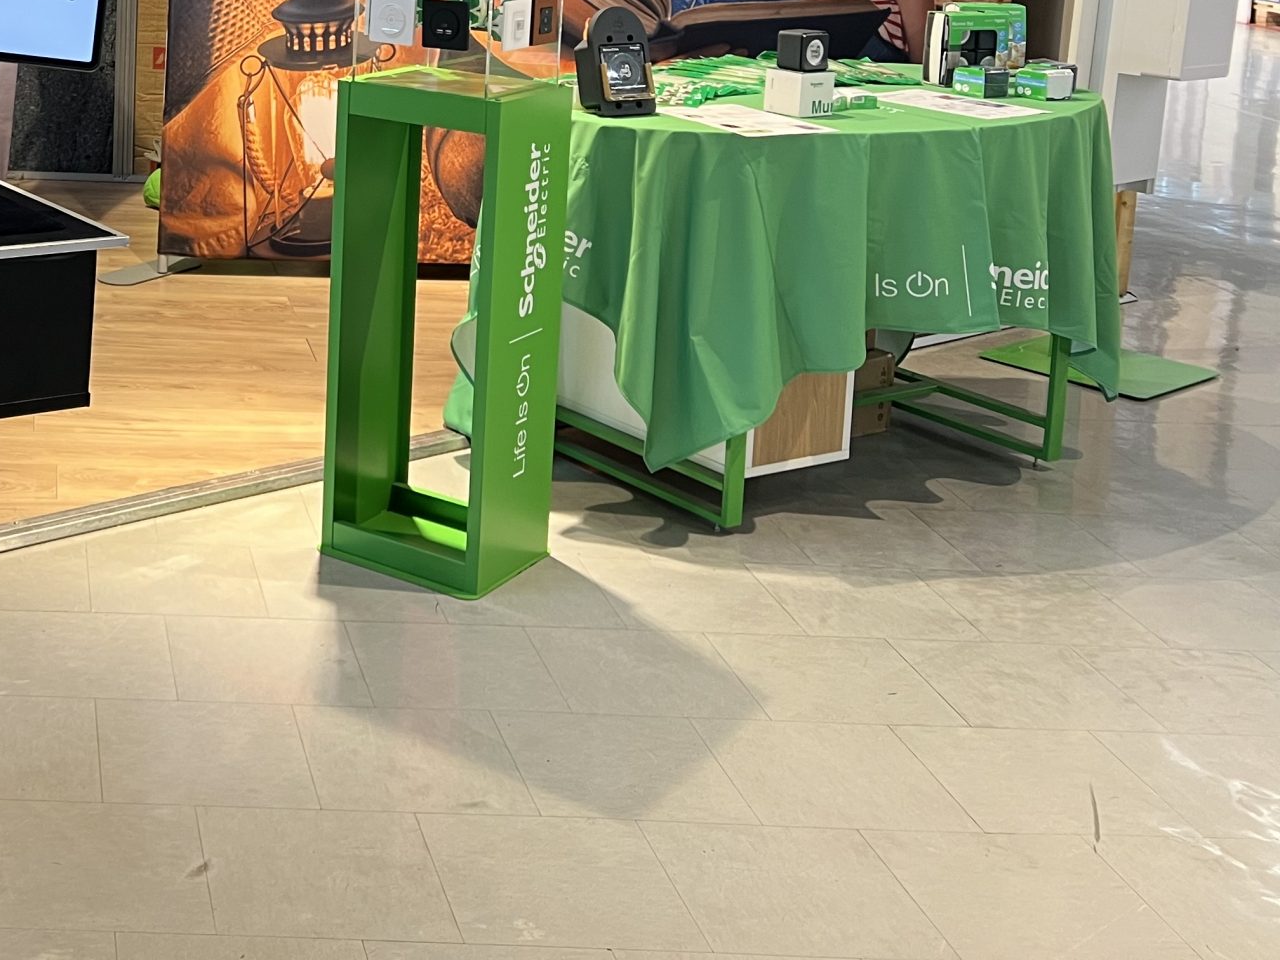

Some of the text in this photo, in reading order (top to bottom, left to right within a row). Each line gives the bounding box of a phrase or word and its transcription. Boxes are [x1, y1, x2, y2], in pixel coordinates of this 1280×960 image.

[518, 142, 542, 319] Schneider
[536, 143, 551, 238] Electric
[875, 271, 950, 298] Is On
[999, 288, 1048, 309] Elec
[512, 354, 531, 478] Life Is On
